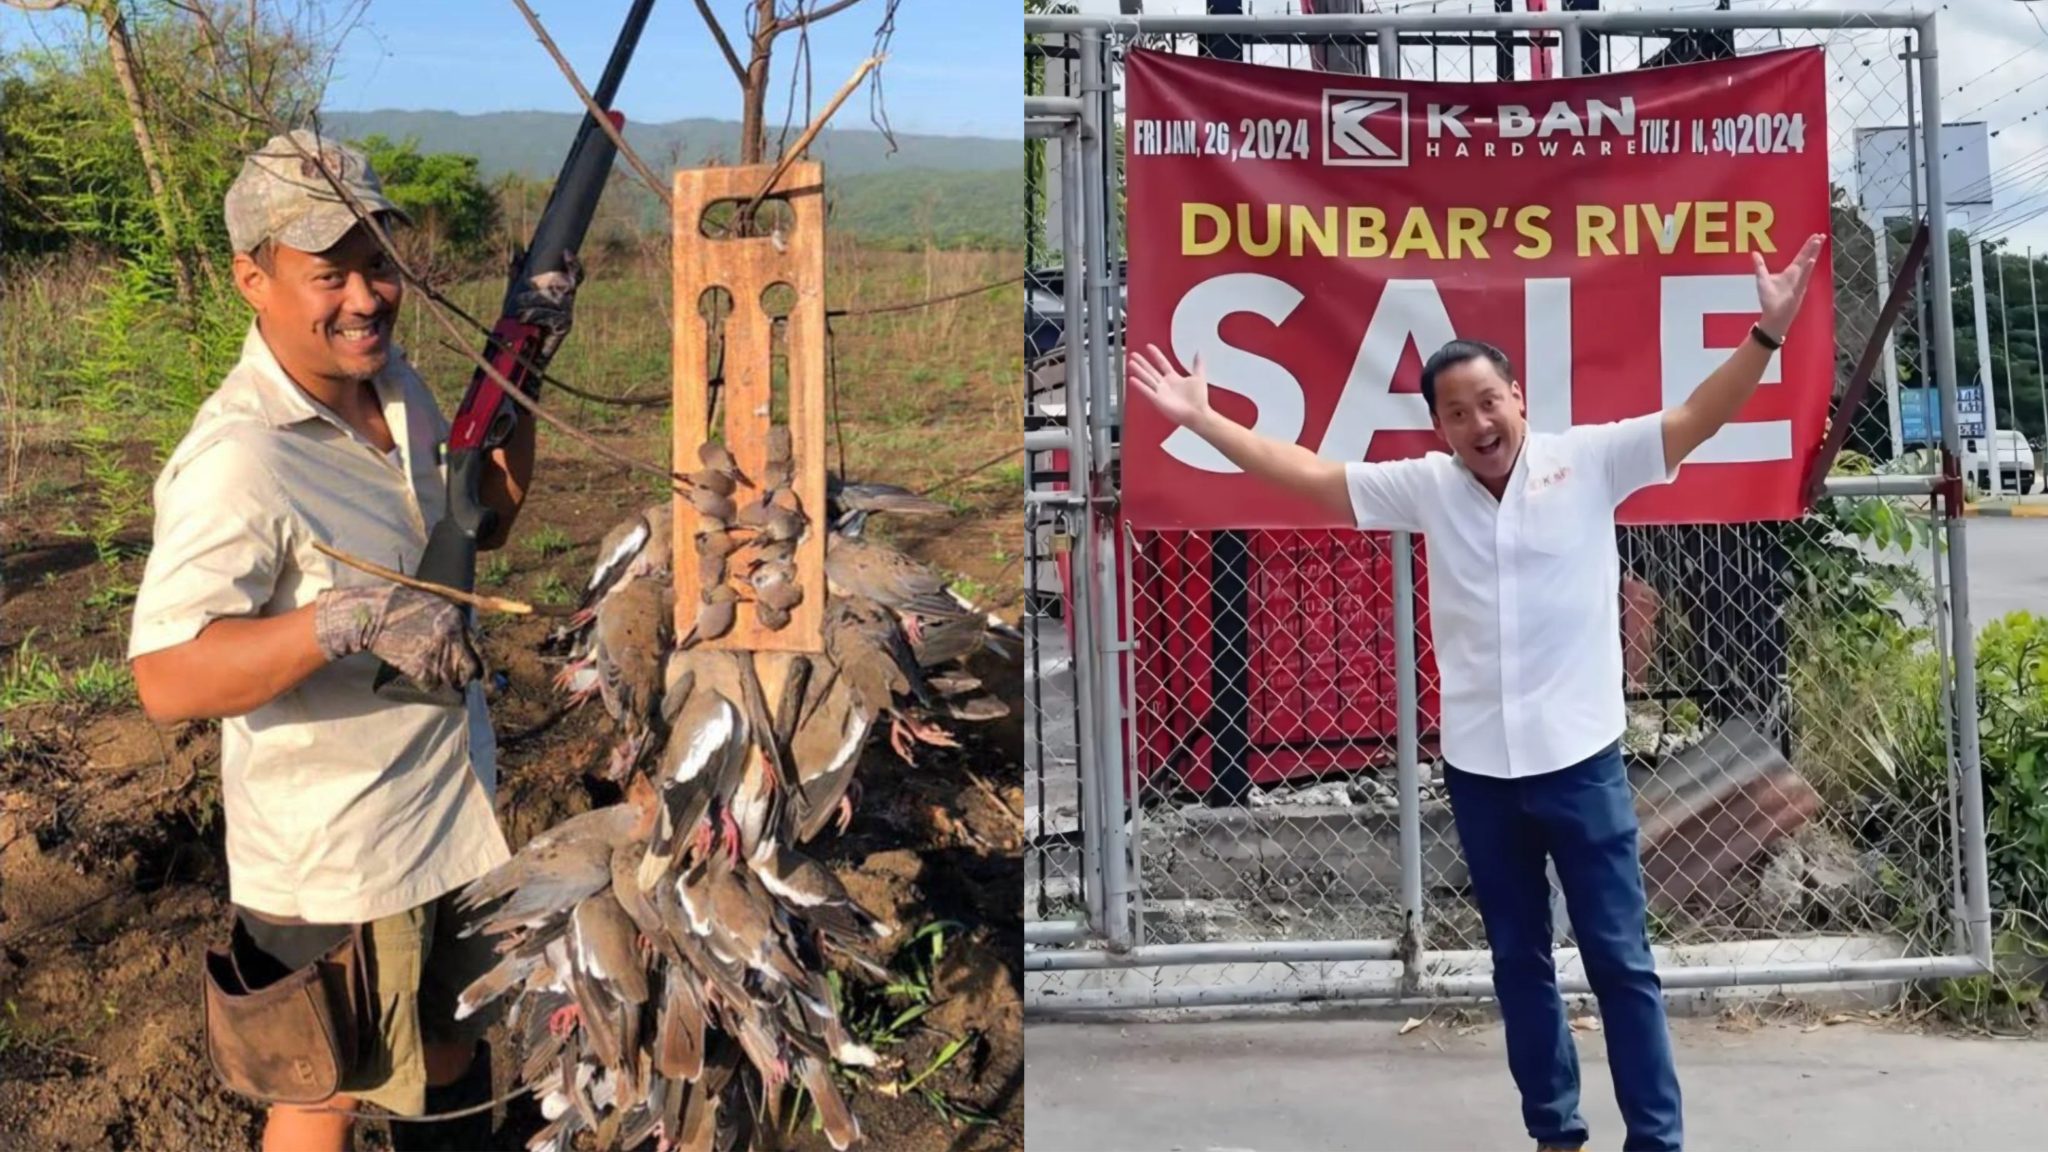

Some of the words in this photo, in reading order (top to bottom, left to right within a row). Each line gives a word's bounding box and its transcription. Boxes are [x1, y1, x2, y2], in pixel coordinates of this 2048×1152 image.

[1426, 96, 1637, 139] K-BAN
[1133, 119, 1162, 155] FRI
[1426, 141, 1637, 158] HARDWARE
[1639, 119, 1670, 154] TUE
[1181, 202, 1553, 260] DUNBAR'S
[1576, 200, 1778, 257] RIVER
